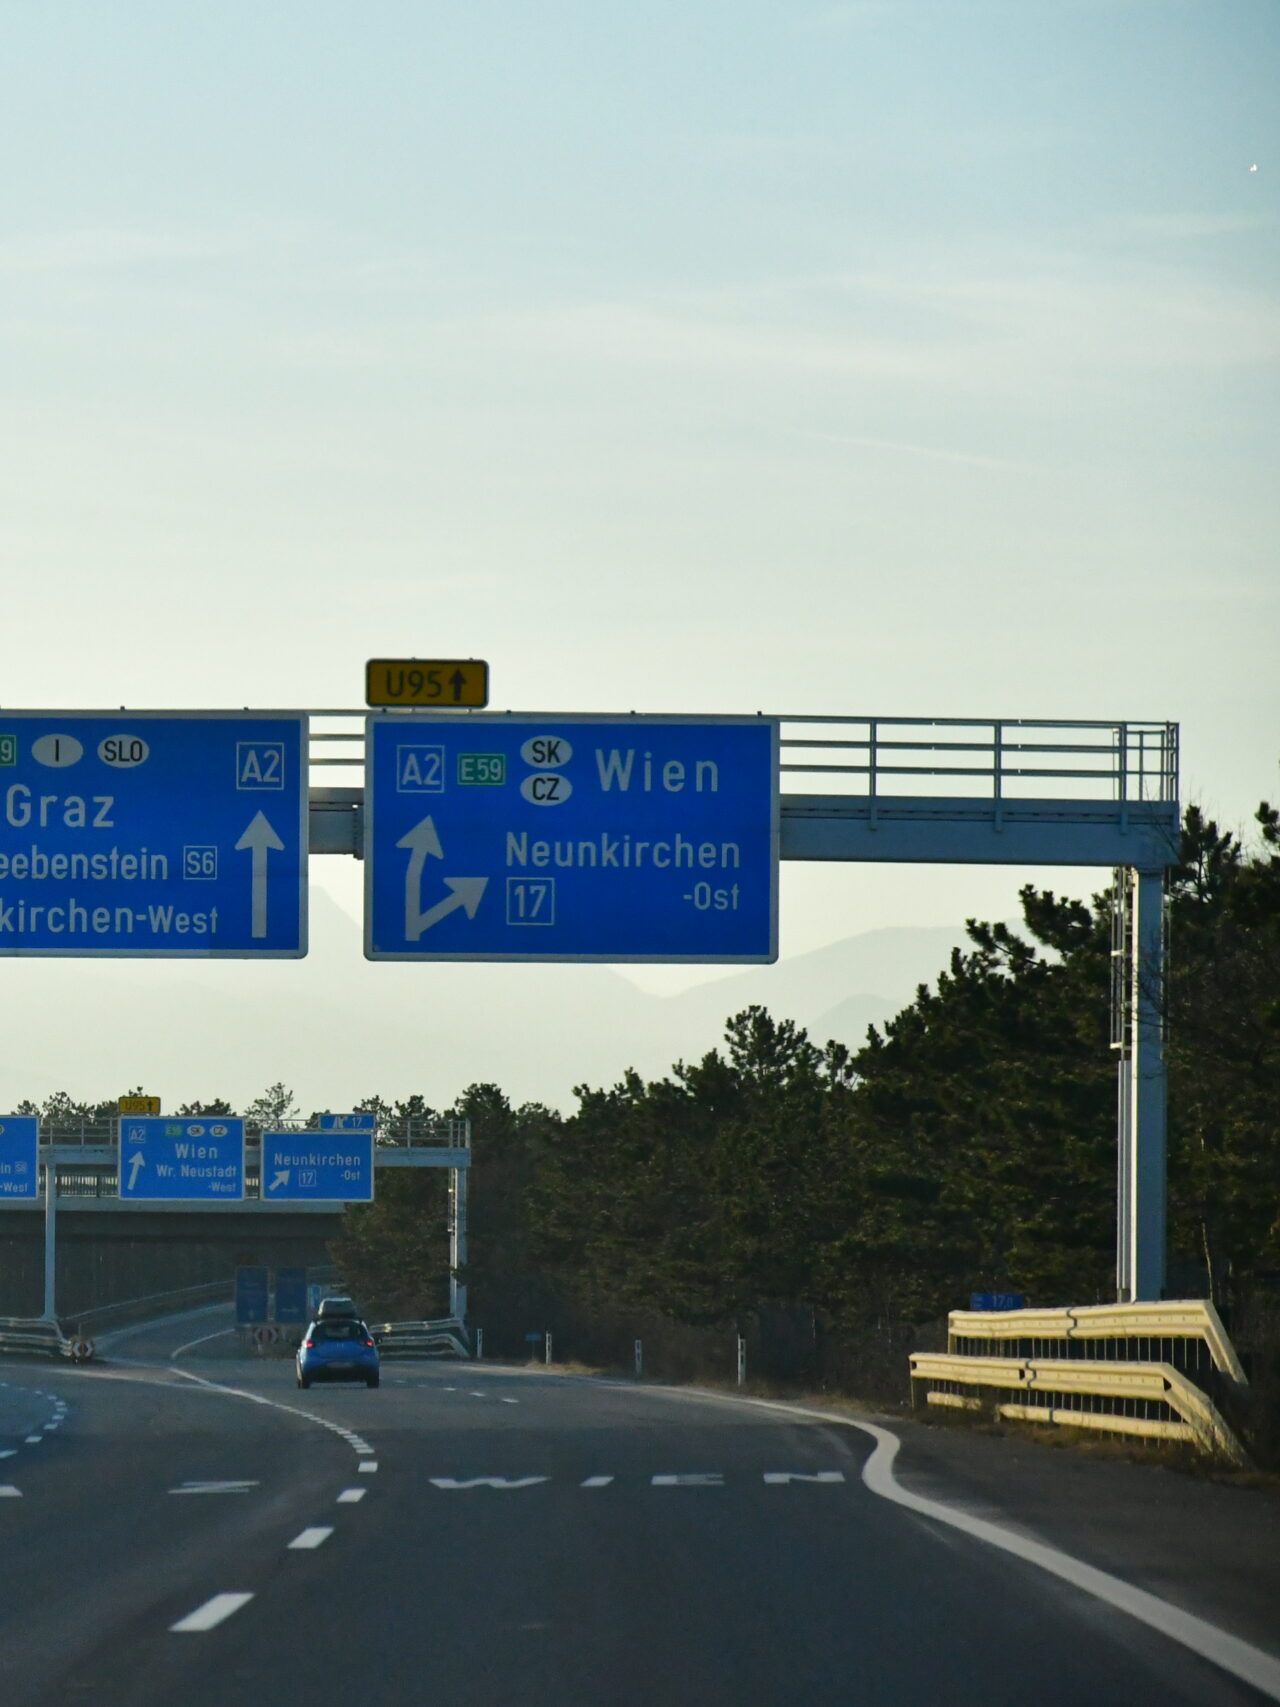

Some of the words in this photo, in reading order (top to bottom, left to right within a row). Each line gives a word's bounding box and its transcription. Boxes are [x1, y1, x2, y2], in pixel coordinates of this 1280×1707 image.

[385, 669, 442, 697] U95
[53, 739, 60, 762] I
[103, 740, 143, 762] SLO
[531, 741, 561, 763] SK
[241, 750, 280, 783] A2
[402, 753, 441, 786] A2
[461, 758, 502, 781] E59
[595, 748, 718, 792] Wien
[531, 778, 560, 800] CZ
[6, 784, 114, 828] Graz
[506, 832, 740, 868] Neunkirchen
[186, 850, 215, 875] S6
[513, 885, 547, 918] 17
[683, 882, 740, 910] -Ost
[352, 1117, 362, 1128] 17
[130, 1128, 145, 1141] A2
[175, 1143, 218, 1159] Wien
[274, 1153, 361, 1166] Neunkirchen
[181, 1164, 237, 1178] Neustadt
[302, 1172, 314, 1185] 17
